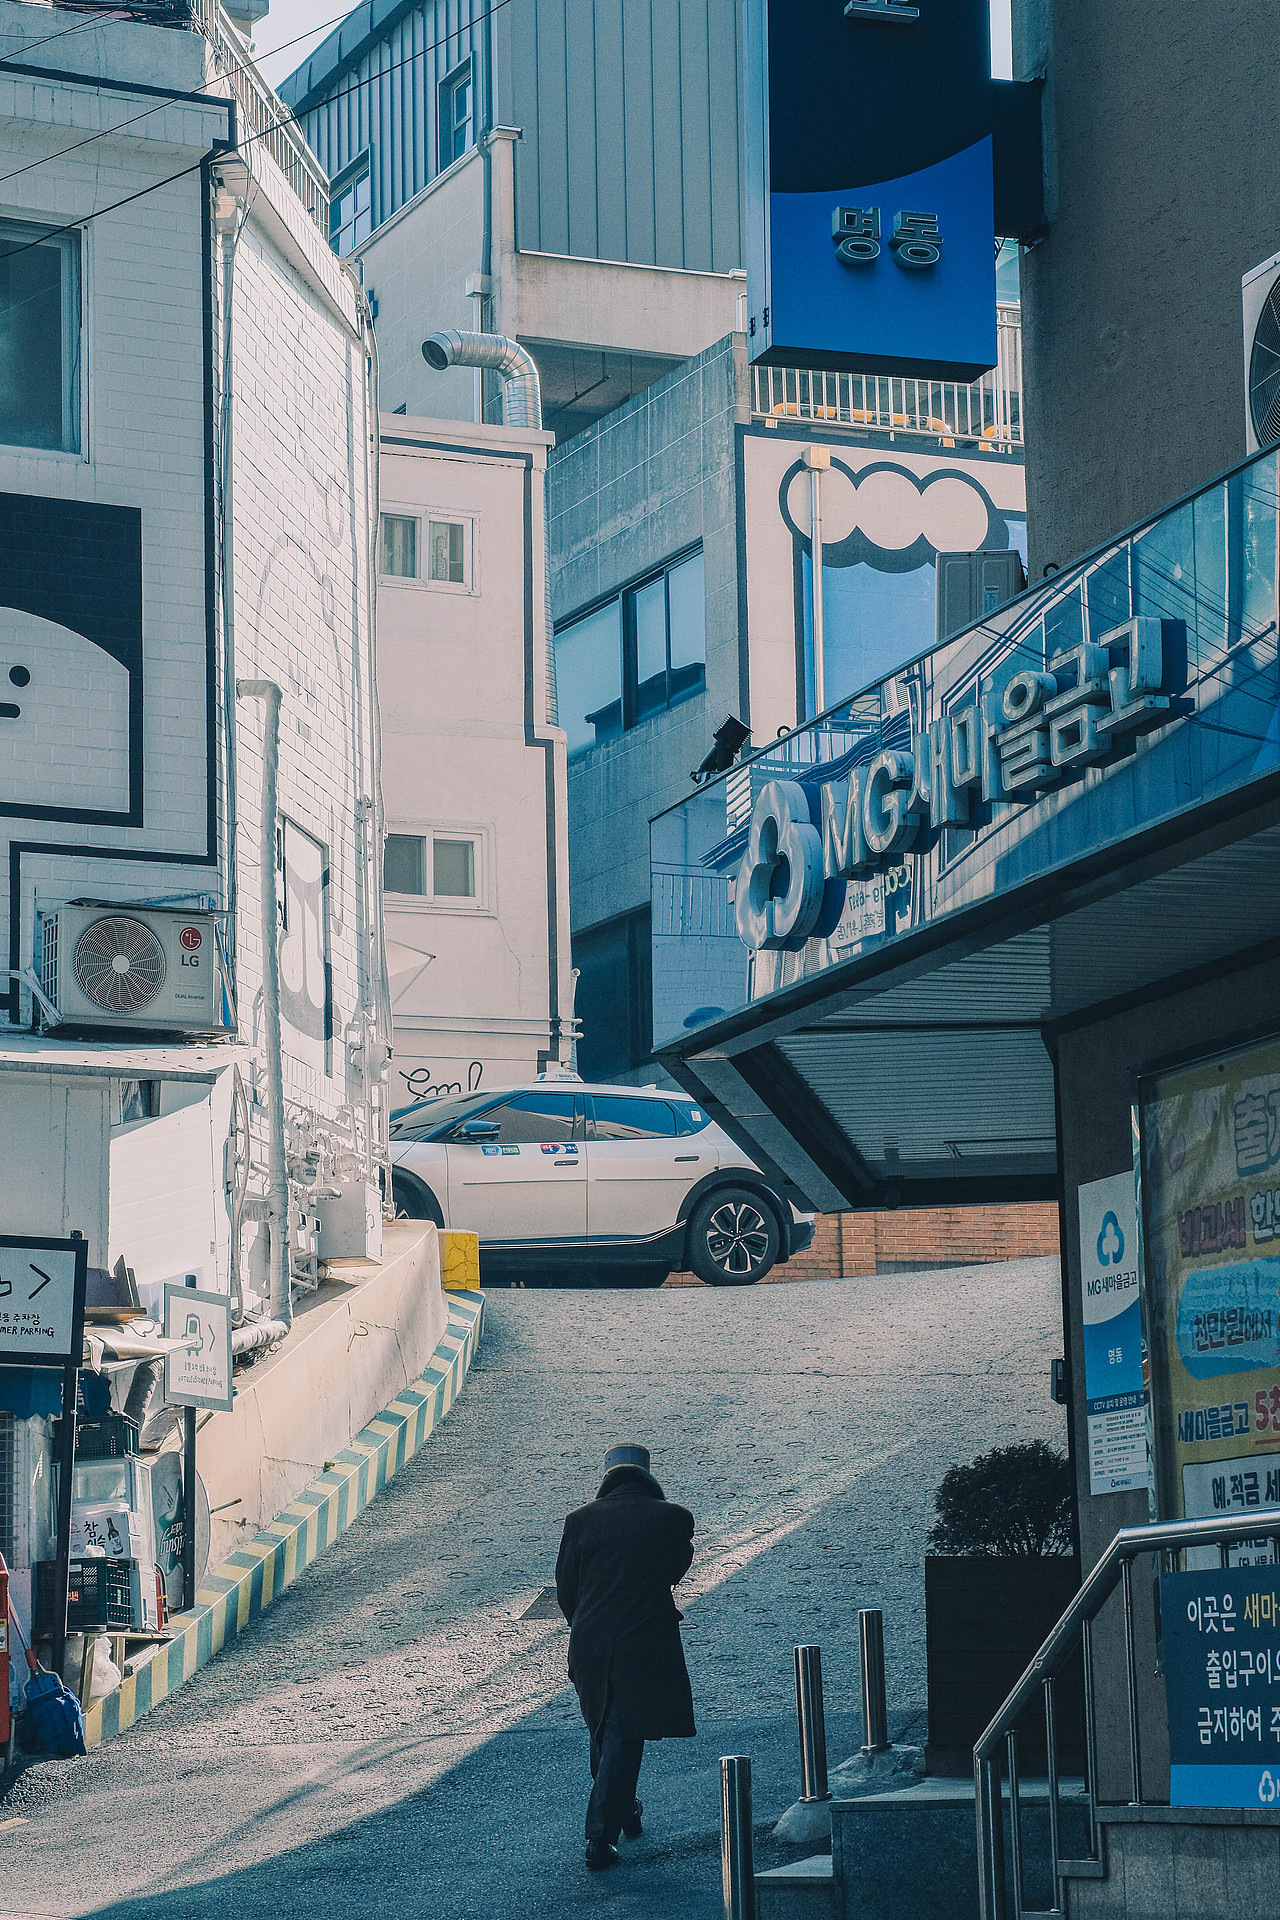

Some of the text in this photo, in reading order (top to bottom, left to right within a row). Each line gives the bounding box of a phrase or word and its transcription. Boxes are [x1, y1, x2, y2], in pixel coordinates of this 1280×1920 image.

[832, 206, 944, 270] 명동
[820, 616, 1172, 879] MG새마을금고
[181, 954, 199, 967] LG
[1177, 1196, 1247, 1258] 비과세
[1087, 1270, 1138, 1297] MG새마을금고
[0, 1312, 41, 1326] 용 주차장
[0, 1326, 55, 1338] MER PARKING
[1108, 1347, 1123, 1365] 명동
[1178, 1402, 1250, 1443] 새마을금고
[1212, 1471, 1260, 1509] 예.적금
[84, 1520, 99, 1538] 참
[1187, 1591, 1280, 1634] 이곳은 새마
[1197, 1705, 1262, 1745] 금지하여
